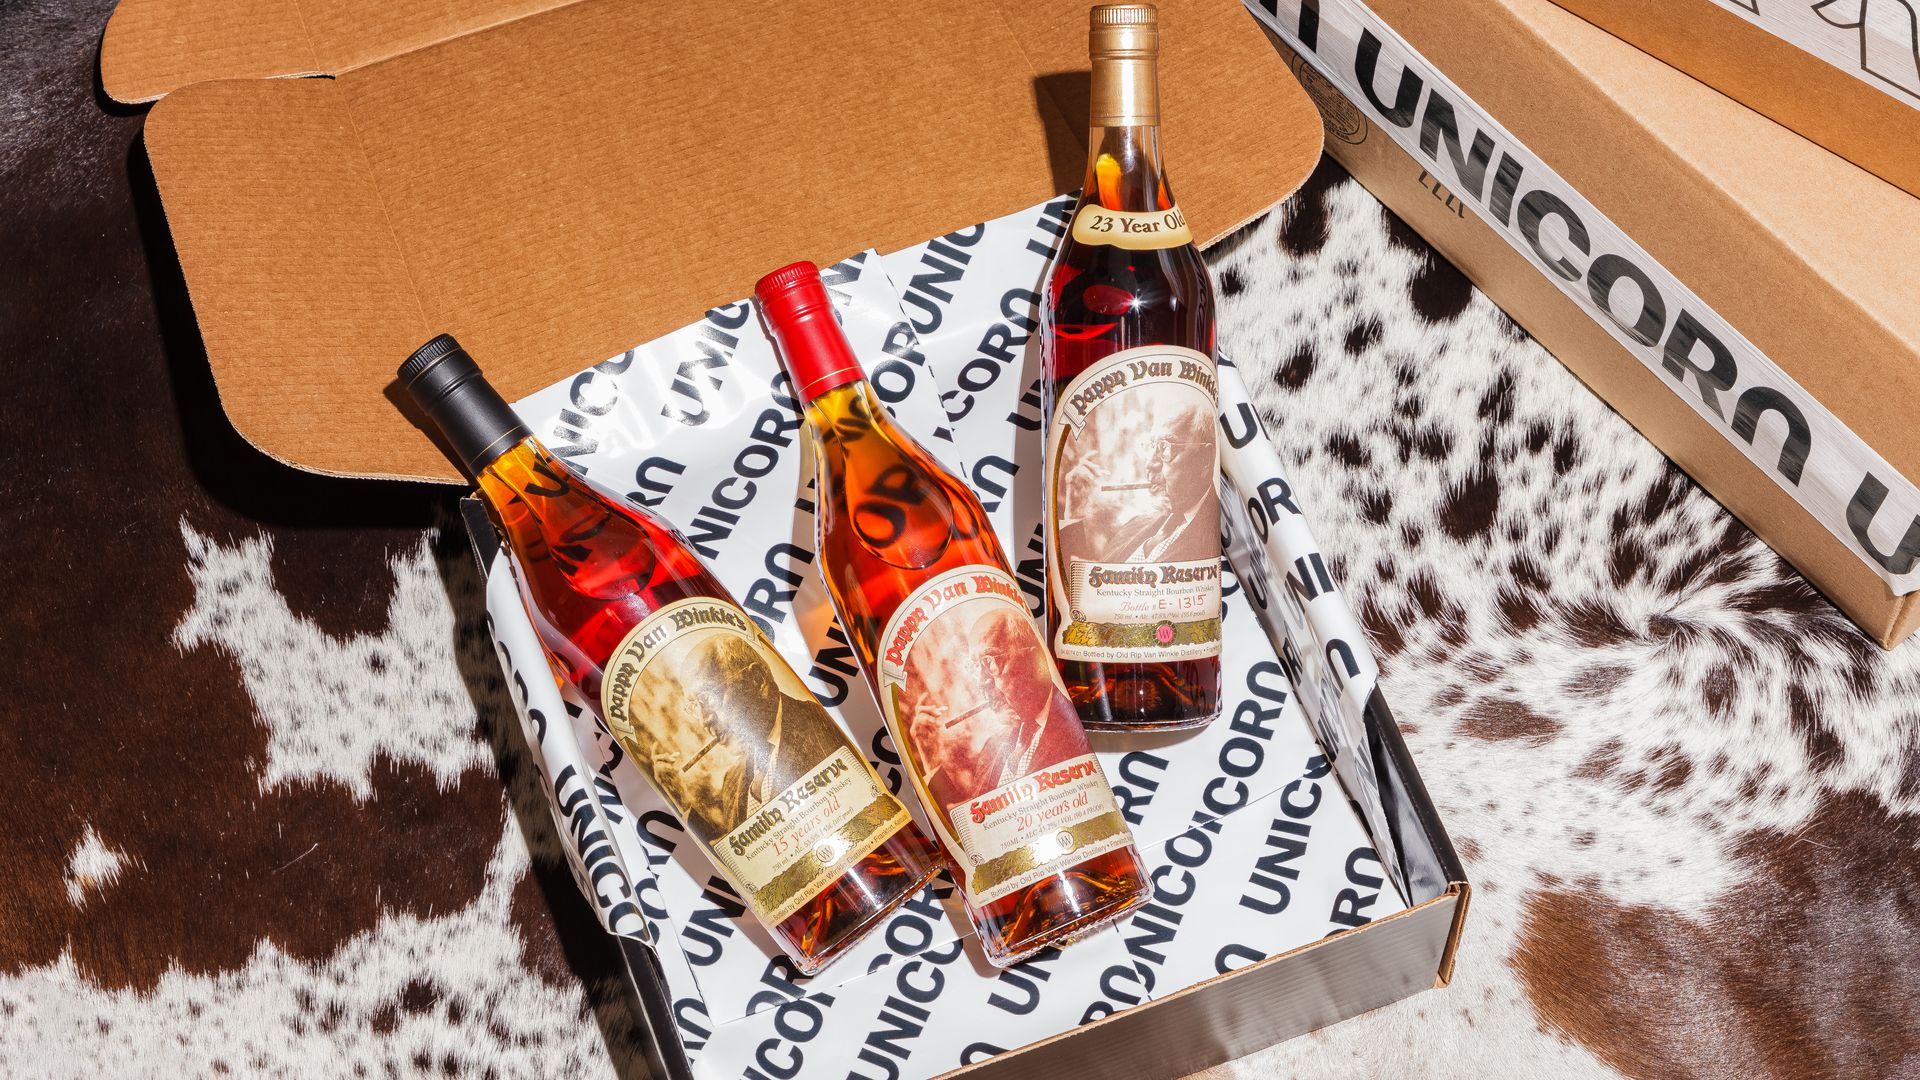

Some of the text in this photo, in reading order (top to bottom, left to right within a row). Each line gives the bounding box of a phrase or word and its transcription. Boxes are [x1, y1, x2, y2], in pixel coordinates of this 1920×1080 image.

[1090, 210, 1186, 234] 23 Year Old
[1069, 368, 1127, 416] Pappy
[1126, 360, 1173, 381] Van
[1088, 565, 1159, 588] Family
[1096, 588, 1133, 599] Kentucky
[1134, 587, 1165, 598] Straight
[1166, 586, 1194, 595] Bourbon
[884, 606, 929, 668] Pappy
[921, 581, 969, 609] Van
[1119, 601, 1150, 612] Bottle
[609, 662, 640, 723] Pappy
[625, 624, 667, 663] Van
[1083, 649, 1105, 658] Bottled
[1106, 650, 1115, 660] by
[1116, 650, 1128, 659] Old
[1130, 651, 1142, 660] Rip
[1143, 651, 1157, 659] Van
[1157, 649, 1180, 658] Winkle
[728, 805, 786, 857] Family
[779, 757, 849, 813] Reserve
[746, 777, 852, 862] Kentucky Straight Bourbon Whiskey
[969, 781, 1037, 825] Family
[982, 811, 1017, 831] Kentucky
[1017, 797, 1048, 815] Straight
[1047, 786, 1077, 802] Bourbon
[1016, 791, 1089, 832] 20 years old
[773, 799, 842, 858] 15 years old
[787, 902, 796, 915] by
[793, 892, 807, 907] Old
[804, 884, 816, 897] Rip
[814, 874, 828, 890] Van
[990, 884, 1012, 898] Bottled
[1010, 879, 1021, 892] by
[1019, 873, 1033, 888] Old
[1032, 869, 1045, 883] Rip
[1044, 862, 1060, 875] Van
[1059, 855, 1083, 870] Winkle
